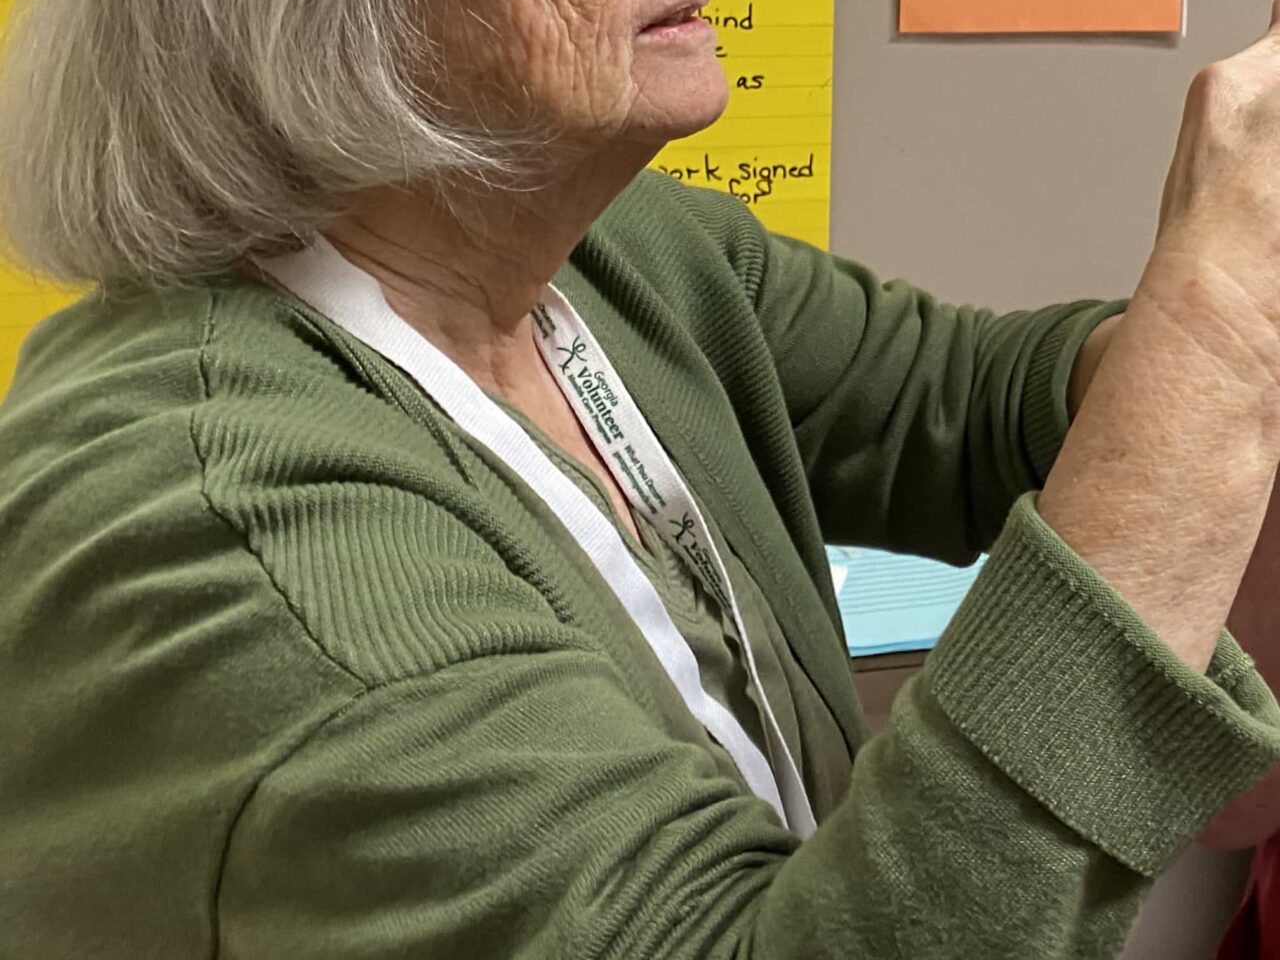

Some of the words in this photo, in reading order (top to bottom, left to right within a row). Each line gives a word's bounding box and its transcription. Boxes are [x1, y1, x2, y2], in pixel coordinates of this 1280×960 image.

[736, 74, 765, 90] as
[737, 153, 814, 197] signed
[577, 365, 625, 441] Volunteer
[593, 370, 619, 408] Georgia
[636, 463, 649, 482] You
